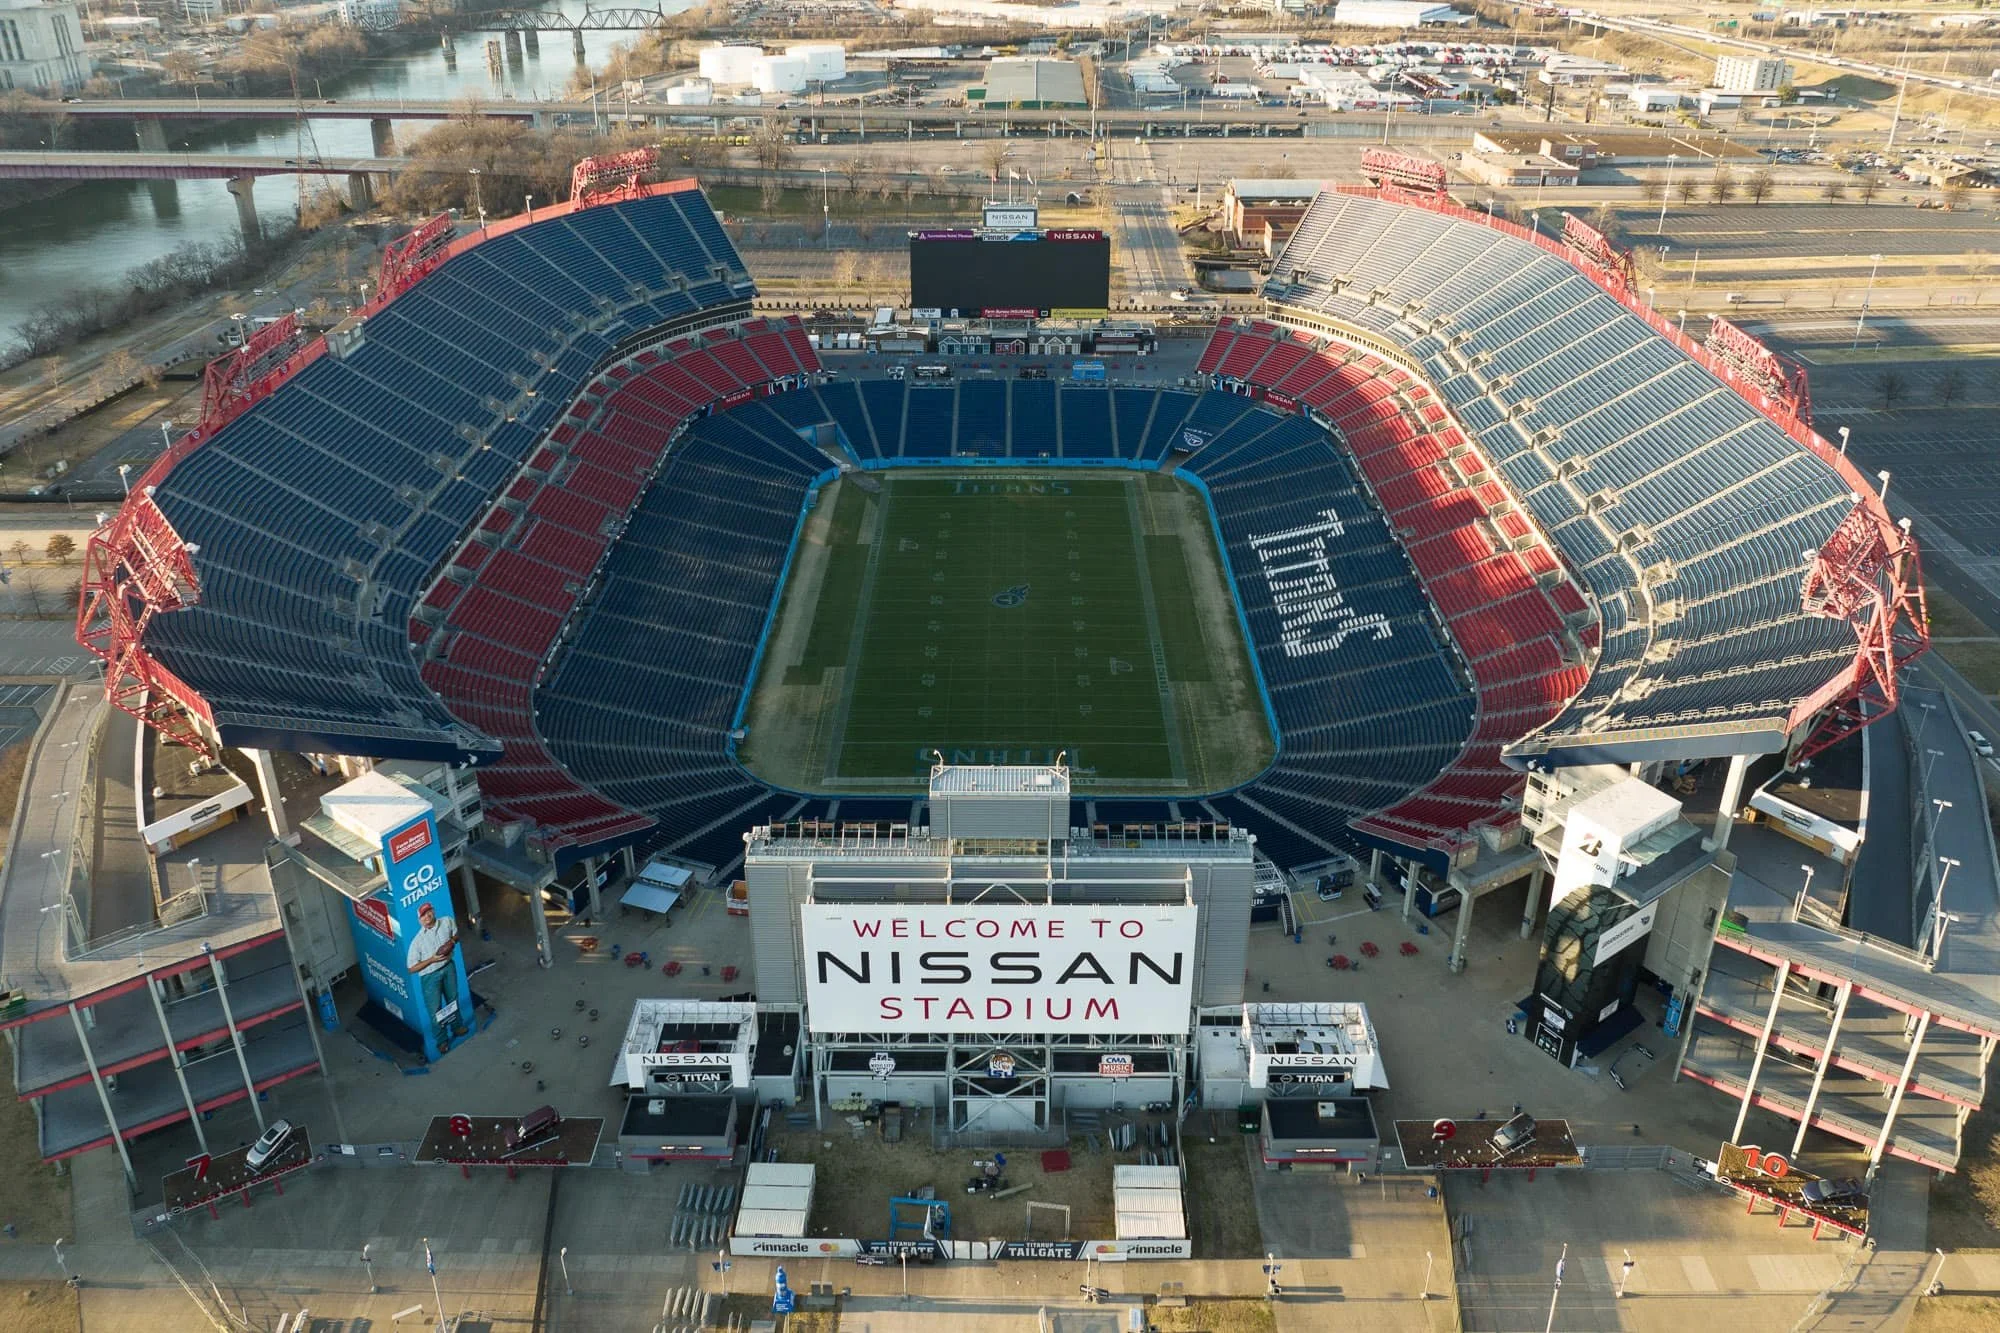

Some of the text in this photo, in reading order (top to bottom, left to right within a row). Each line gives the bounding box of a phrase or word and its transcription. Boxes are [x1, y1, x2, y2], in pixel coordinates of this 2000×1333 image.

[982, 232, 1009, 241] Pinnacle
[725, 391, 751, 403] NISSAN
[1268, 393, 1293, 405] NISSAN
[1249, 508, 1393, 657] TITANS
[403, 864, 434, 891] GO
[400, 874, 443, 908] TITANS!
[853, 920, 1144, 938] WELCOME TO
[817, 951, 1183, 985] NISSAN
[880, 997, 1120, 1020] STADIUM
[642, 1055, 729, 1064] NISSAN
[1270, 1056, 1358, 1065] NISSAN
[681, 1073, 720, 1082] TITAN
[1296, 1075, 1334, 1083] TITAN
[450, 1113, 472, 1137] 8
[1432, 1118, 1456, 1140] 9
[185, 1152, 212, 1181] 7
[1741, 1145, 1789, 1179] 10
[752, 1242, 809, 1253] Pinnacle
[1008, 1247, 1072, 1259] TAILGATE
[1127, 1243, 1183, 1254] Pinnacle
